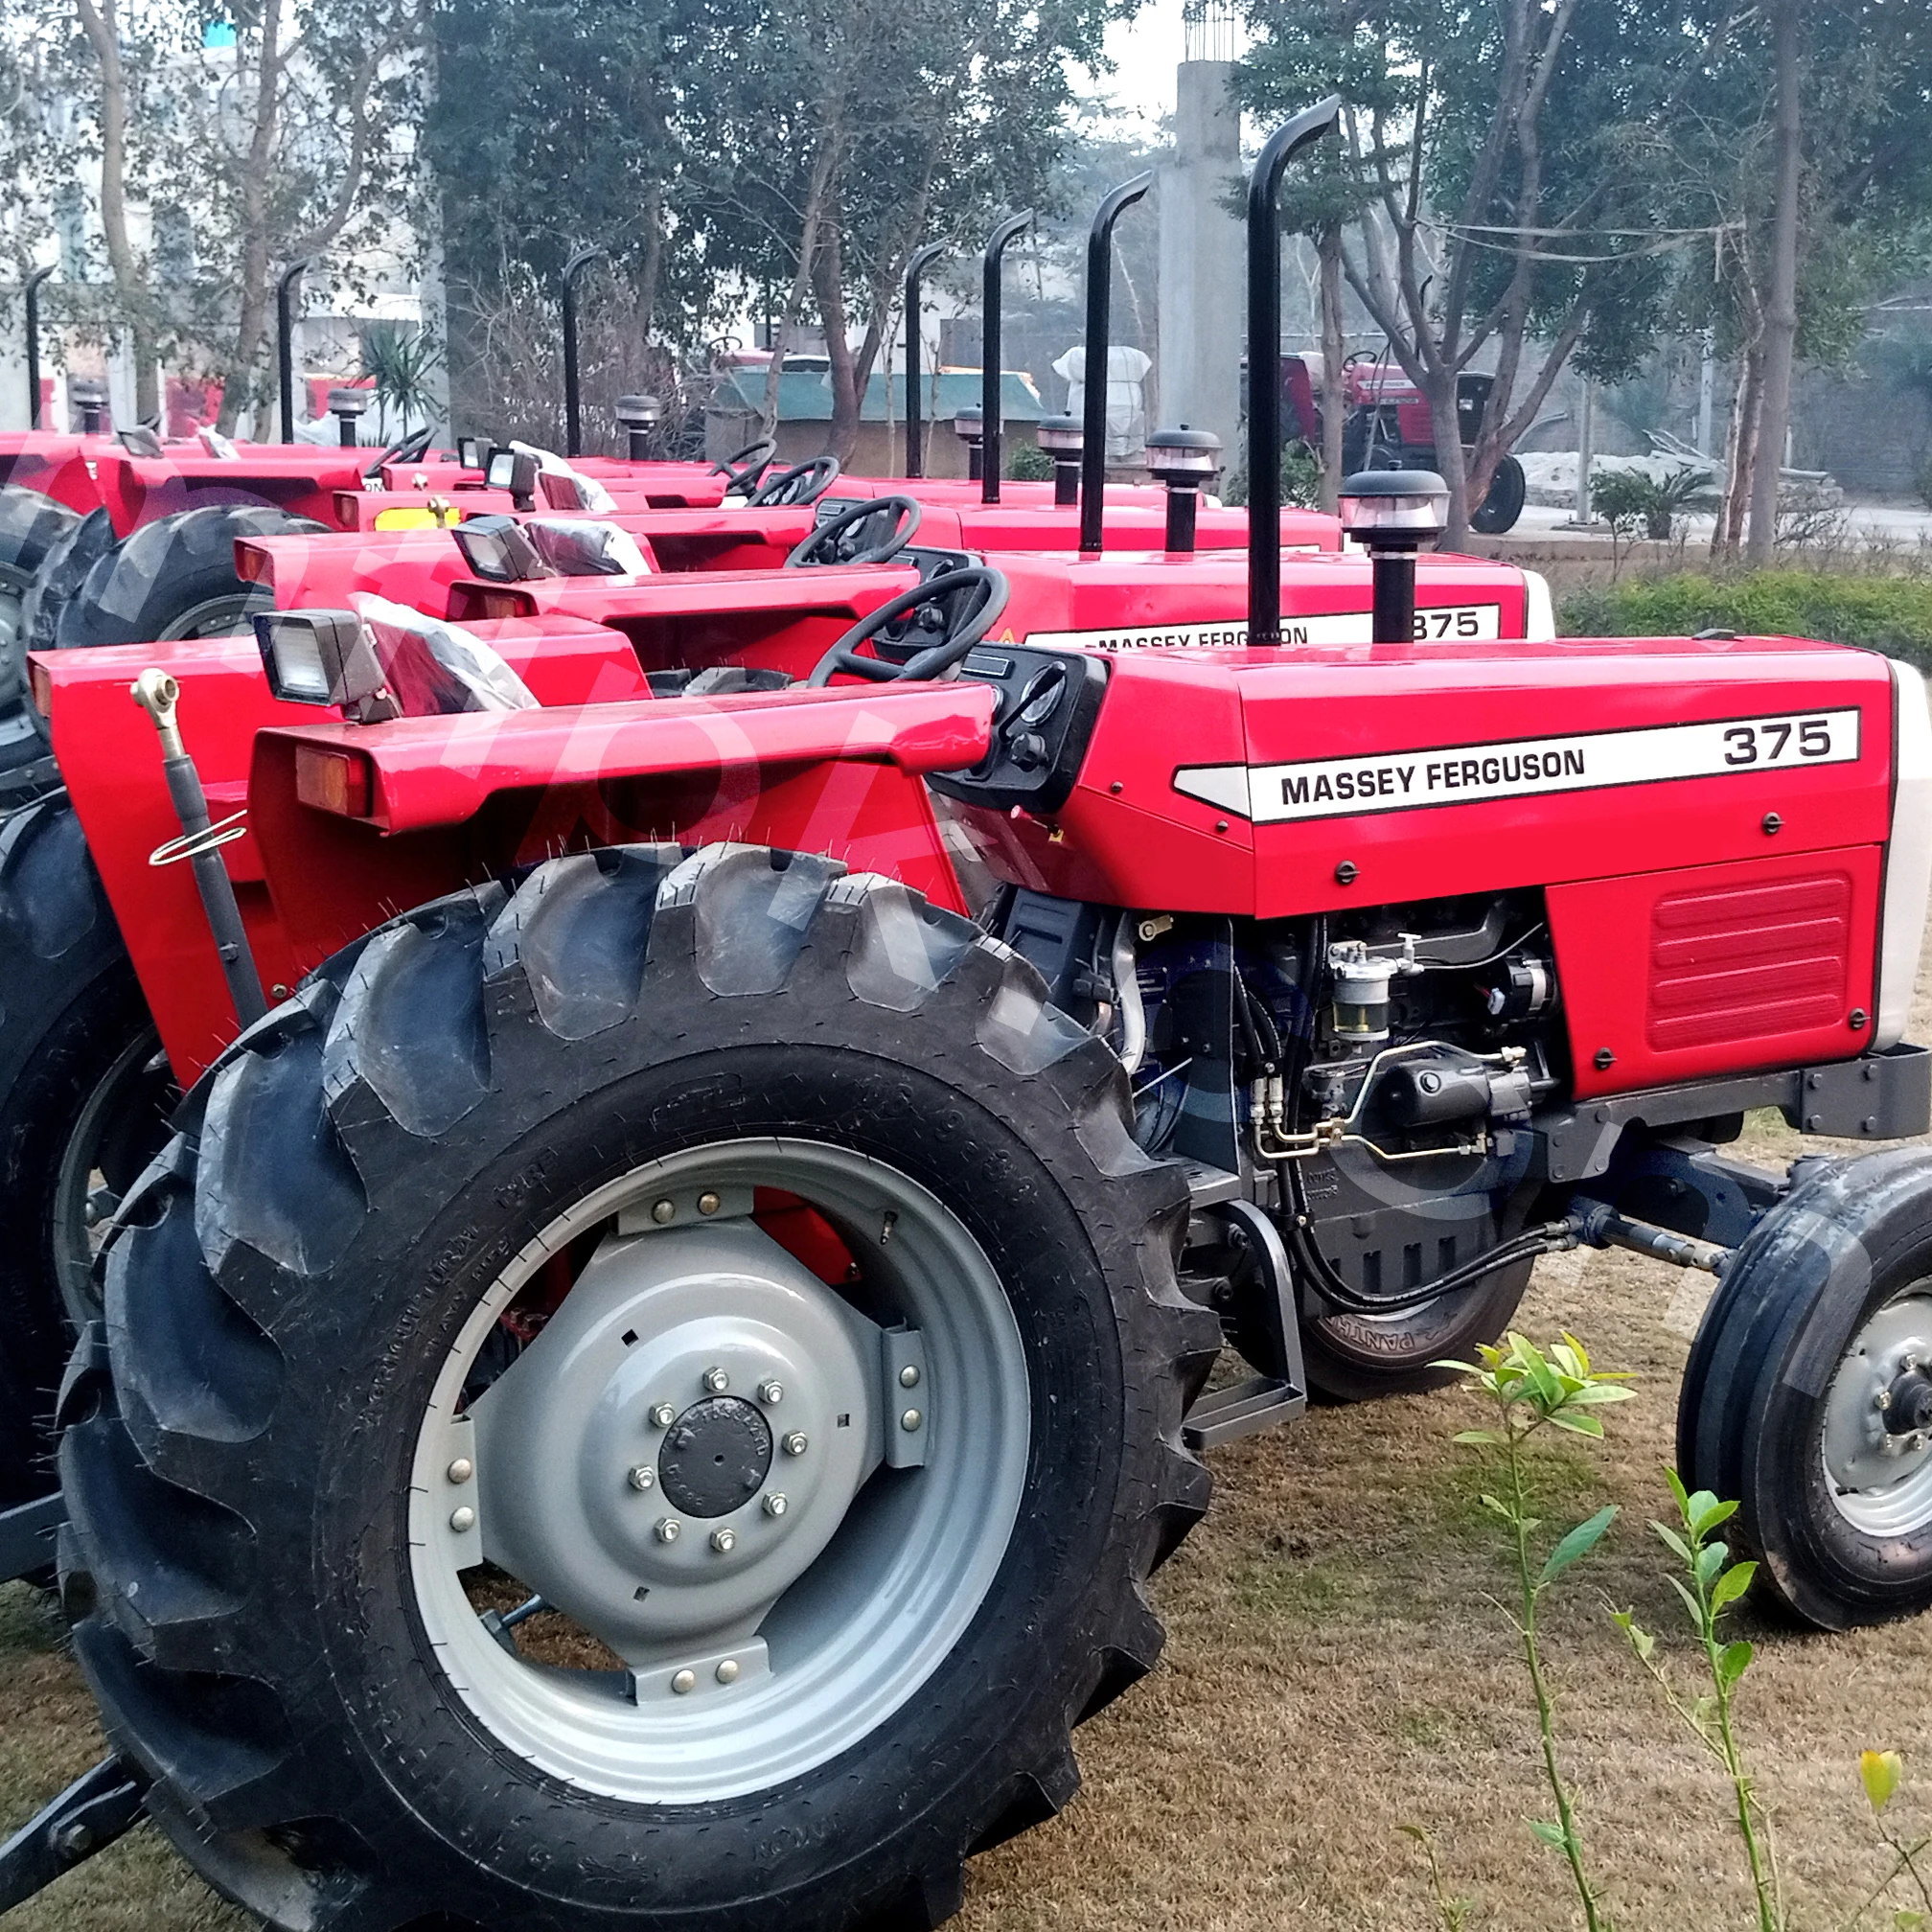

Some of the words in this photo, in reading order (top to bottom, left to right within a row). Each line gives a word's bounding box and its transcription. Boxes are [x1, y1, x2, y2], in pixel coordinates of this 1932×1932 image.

[1198, 627, 1307, 647] FERGON
[1723, 719, 1831, 766] 375
[1280, 765, 1416, 806] MASSEY
[1426, 748, 1586, 791] FERGUSON
